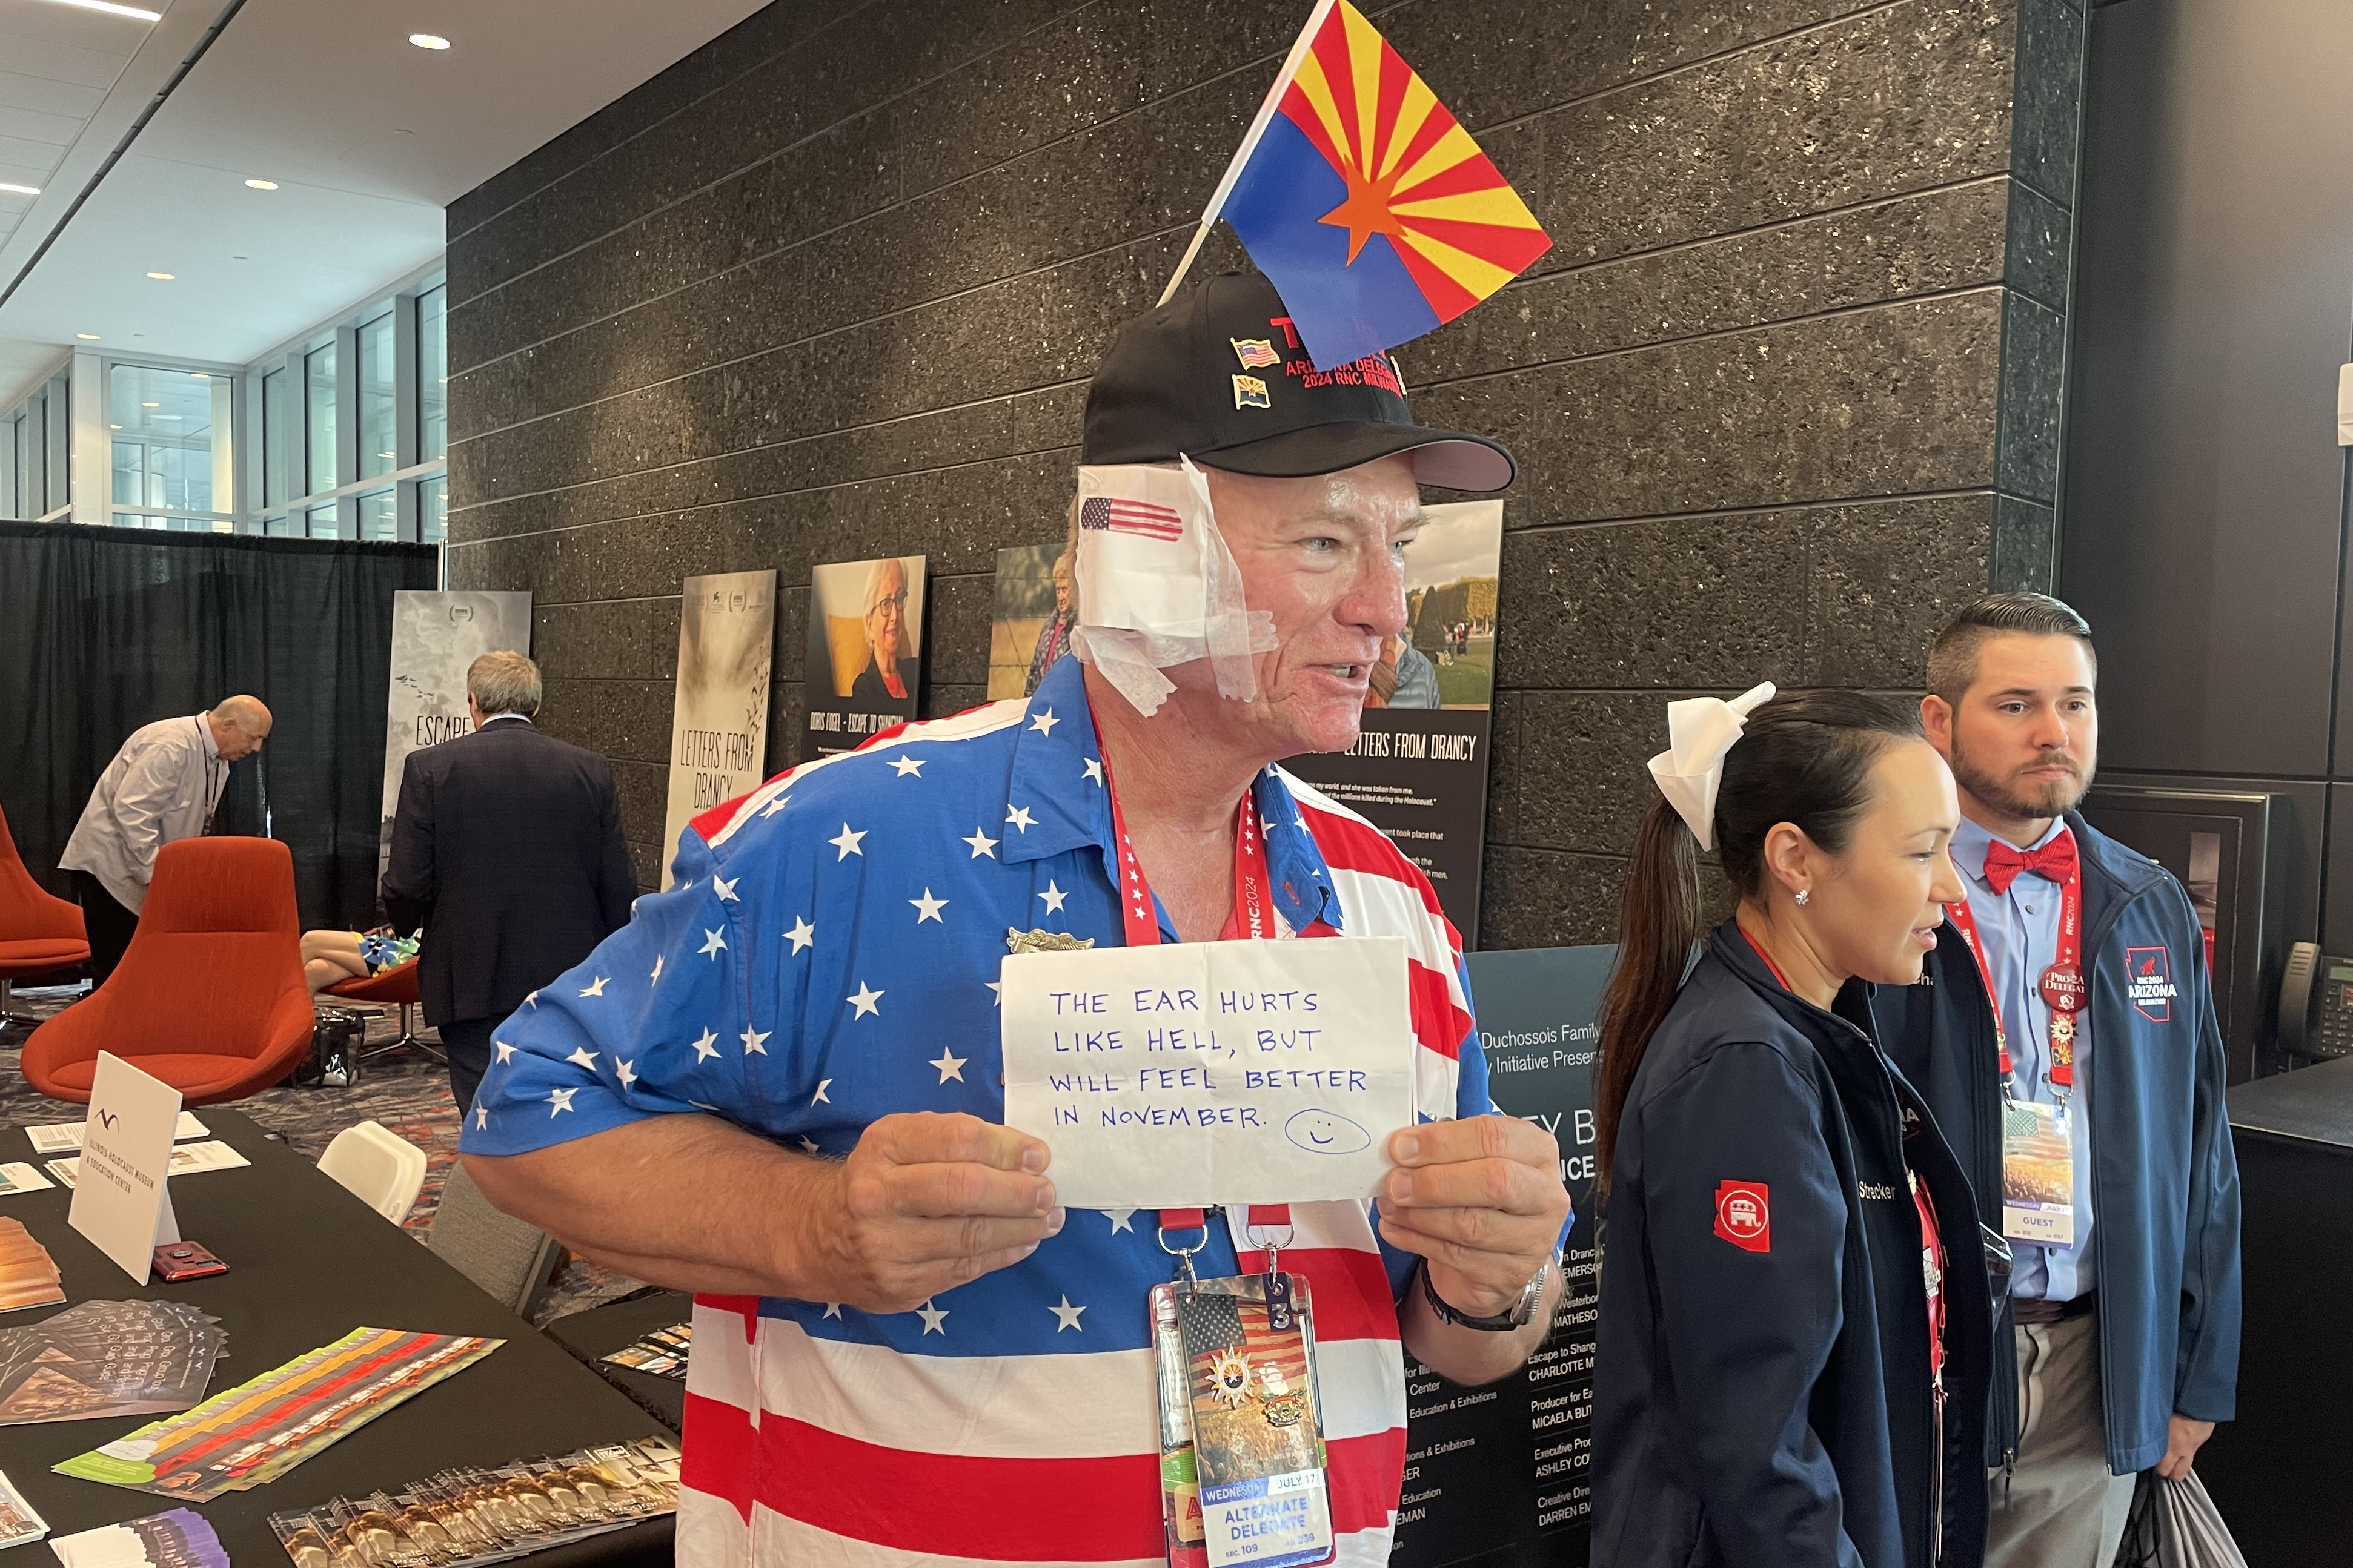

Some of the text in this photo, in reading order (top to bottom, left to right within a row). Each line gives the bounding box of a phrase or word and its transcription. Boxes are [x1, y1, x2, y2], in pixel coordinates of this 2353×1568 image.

[1286, 360, 1352, 377] ARINA
[1303, 372, 1333, 388] 2024
[1335, 372, 1361, 385] RNC
[416, 716, 470, 746] ESCAPE
[848, 713, 868, 733] ESCAPE
[869, 714, 877, 733] TO
[680, 730, 755, 772] LETTERS FROM
[1395, 733, 1427, 759] FROM
[1431, 735, 1476, 761] DRANCY
[694, 772, 733, 810] DRANCY
[1376, 795, 1393, 805] during
[1396, 829, 1411, 838] took
[1412, 830, 1429, 840] place
[1430, 832, 1444, 841] that
[1421, 858, 1433, 866] the
[1245, 876, 1263, 939] RNC2024
[2065, 896, 2076, 936] RNC2024
[2045, 979, 2085, 993] DELEGAT
[2128, 984, 2177, 999] ARIZONA
[1050, 990, 1318, 1015] THE EAR HURTS
[1055, 1028, 1322, 1059] LIKE HELL, BUT
[1482, 1022, 1600, 1050] Duchossois Family
[1496, 1053, 1549, 1074] Initiative
[1049, 1067, 1366, 1091] WILL FEEL BETTER
[1055, 1106, 1266, 1128] IN NOVEMBER.
[90, 1157, 114, 1182] EDUCATION
[115, 1175, 131, 1194] CENTER
[134, 1169, 154, 1191] MUSEUM
[1859, 1180, 1896, 1200] Strecker
[2023, 1216, 2054, 1228] GUEST
[1559, 1294, 1599, 1310] Westerbor
[1272, 1302, 1290, 1329] 3
[1554, 1309, 1598, 1328] MATHESO
[1528, 1342, 1596, 1365] Escape to Shang
[1528, 1359, 1584, 1381] CHARLOTTE
[1409, 1381, 1441, 1396] Center
[1409, 1391, 1498, 1419] Education & Exhibitions
[1531, 1396, 1568, 1412] Producer
[1570, 1392, 1581, 1403] for
[1532, 1410, 1573, 1430] MICAELA
[1426, 1446, 1433, 1457] &
[1435, 1437, 1475, 1455] Exhibitions
[1534, 1442, 1573, 1460] Executive
[1536, 1458, 1572, 1478] ASHLEY
[1278, 1477, 1301, 1489] JULY
[1305, 1474, 1315, 1484] 17
[1402, 1487, 1441, 1505] Education
[1538, 1491, 1571, 1509] Creative
[1225, 1497, 1308, 1524] ALTERNATE
[1539, 1505, 1577, 1527] DARREN
[1230, 1514, 1306, 1541] DELEGATE
[1241, 1543, 1258, 1555] 109
